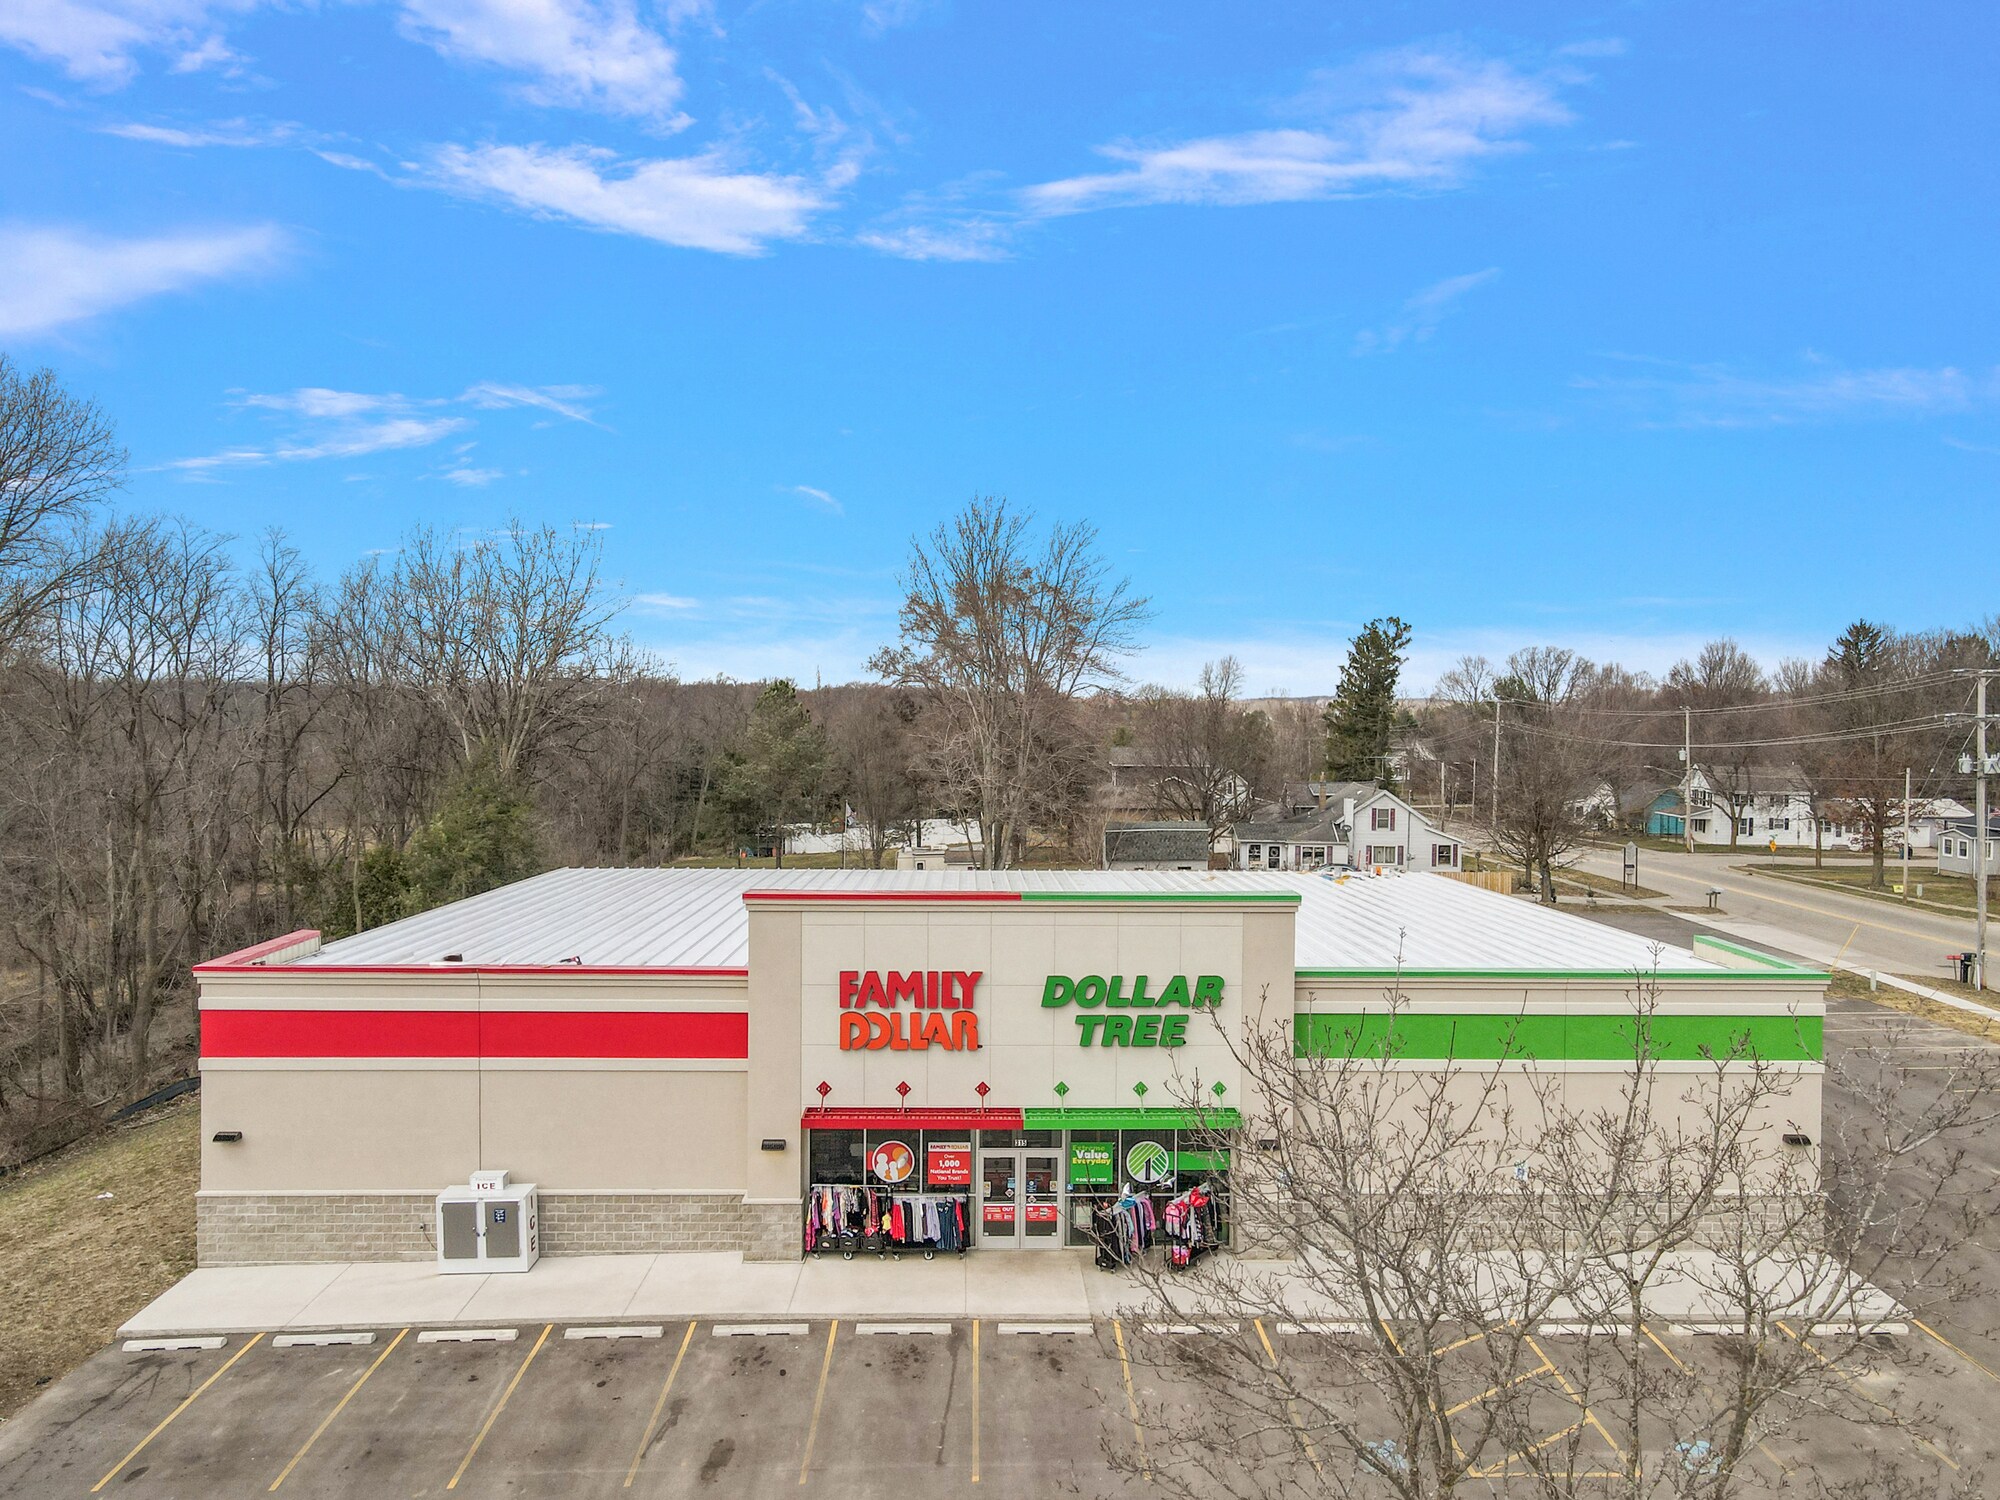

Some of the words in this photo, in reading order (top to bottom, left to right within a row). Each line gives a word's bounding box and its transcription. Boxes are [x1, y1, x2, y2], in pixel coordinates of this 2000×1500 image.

[839, 970, 983, 1009] FAMILY
[1041, 975, 1225, 1008] DOLLAR
[839, 1010, 979, 1051] DOLLAR
[1075, 1014, 1189, 1047] TREE
[938, 1160, 960, 1169] 1,000
[1072, 1157, 1111, 1165] Everyday
[1075, 1150, 1109, 1159] Value
